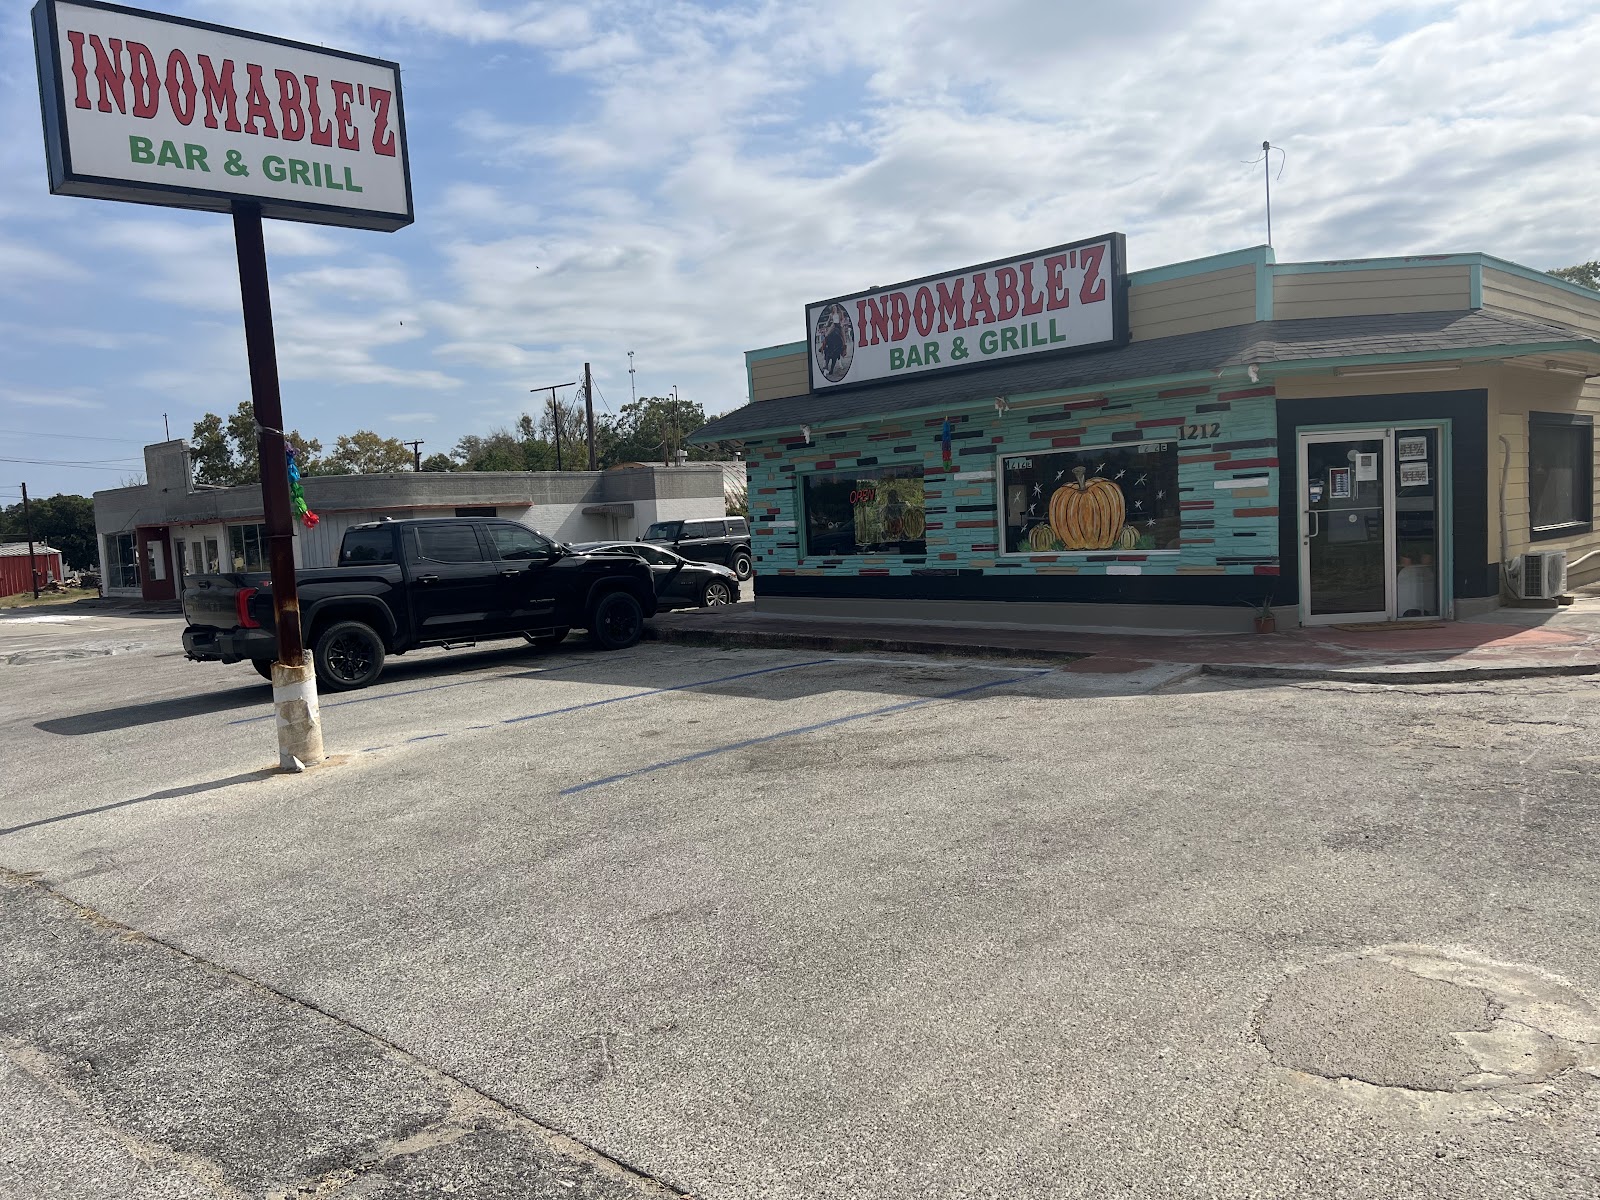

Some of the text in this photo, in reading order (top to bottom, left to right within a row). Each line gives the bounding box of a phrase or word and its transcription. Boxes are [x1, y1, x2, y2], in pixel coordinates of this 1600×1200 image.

[67, 30, 396, 157] INDOMABLE'Z
[129, 135, 363, 193] BAR & GRILL
[856, 244, 1106, 348] INDOMABLE'Z
[889, 318, 1066, 371] BAR & GRILL
[1178, 422, 1221, 441] 1212
[850, 489, 875, 503] OPEN
